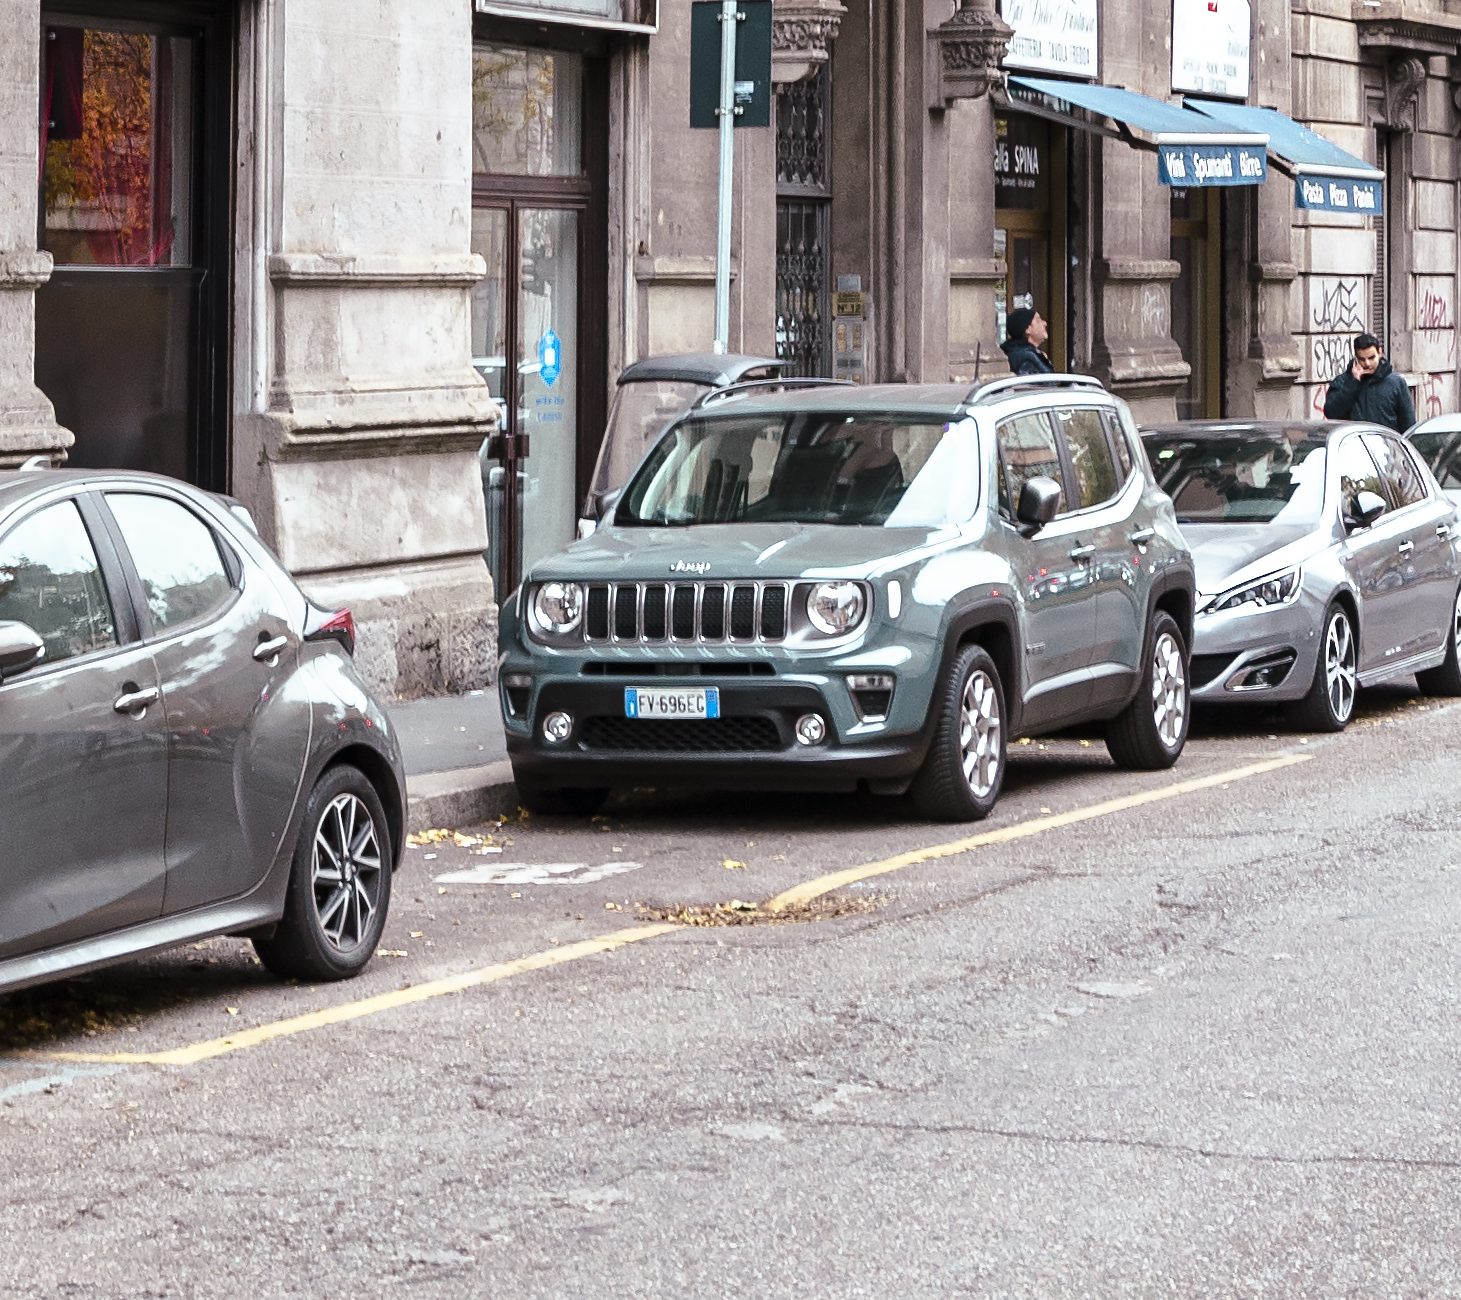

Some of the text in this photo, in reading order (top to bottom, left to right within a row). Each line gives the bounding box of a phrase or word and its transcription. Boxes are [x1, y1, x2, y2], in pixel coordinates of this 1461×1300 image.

[1009, 36, 1042, 58] AFFETTERIA
[1014, 145, 1039, 175] SPINA
[1166, 151, 1186, 177] Vini
[1239, 151, 1263, 177] Birre
[1303, 180, 1375, 209] Pasta Pizza Panini
